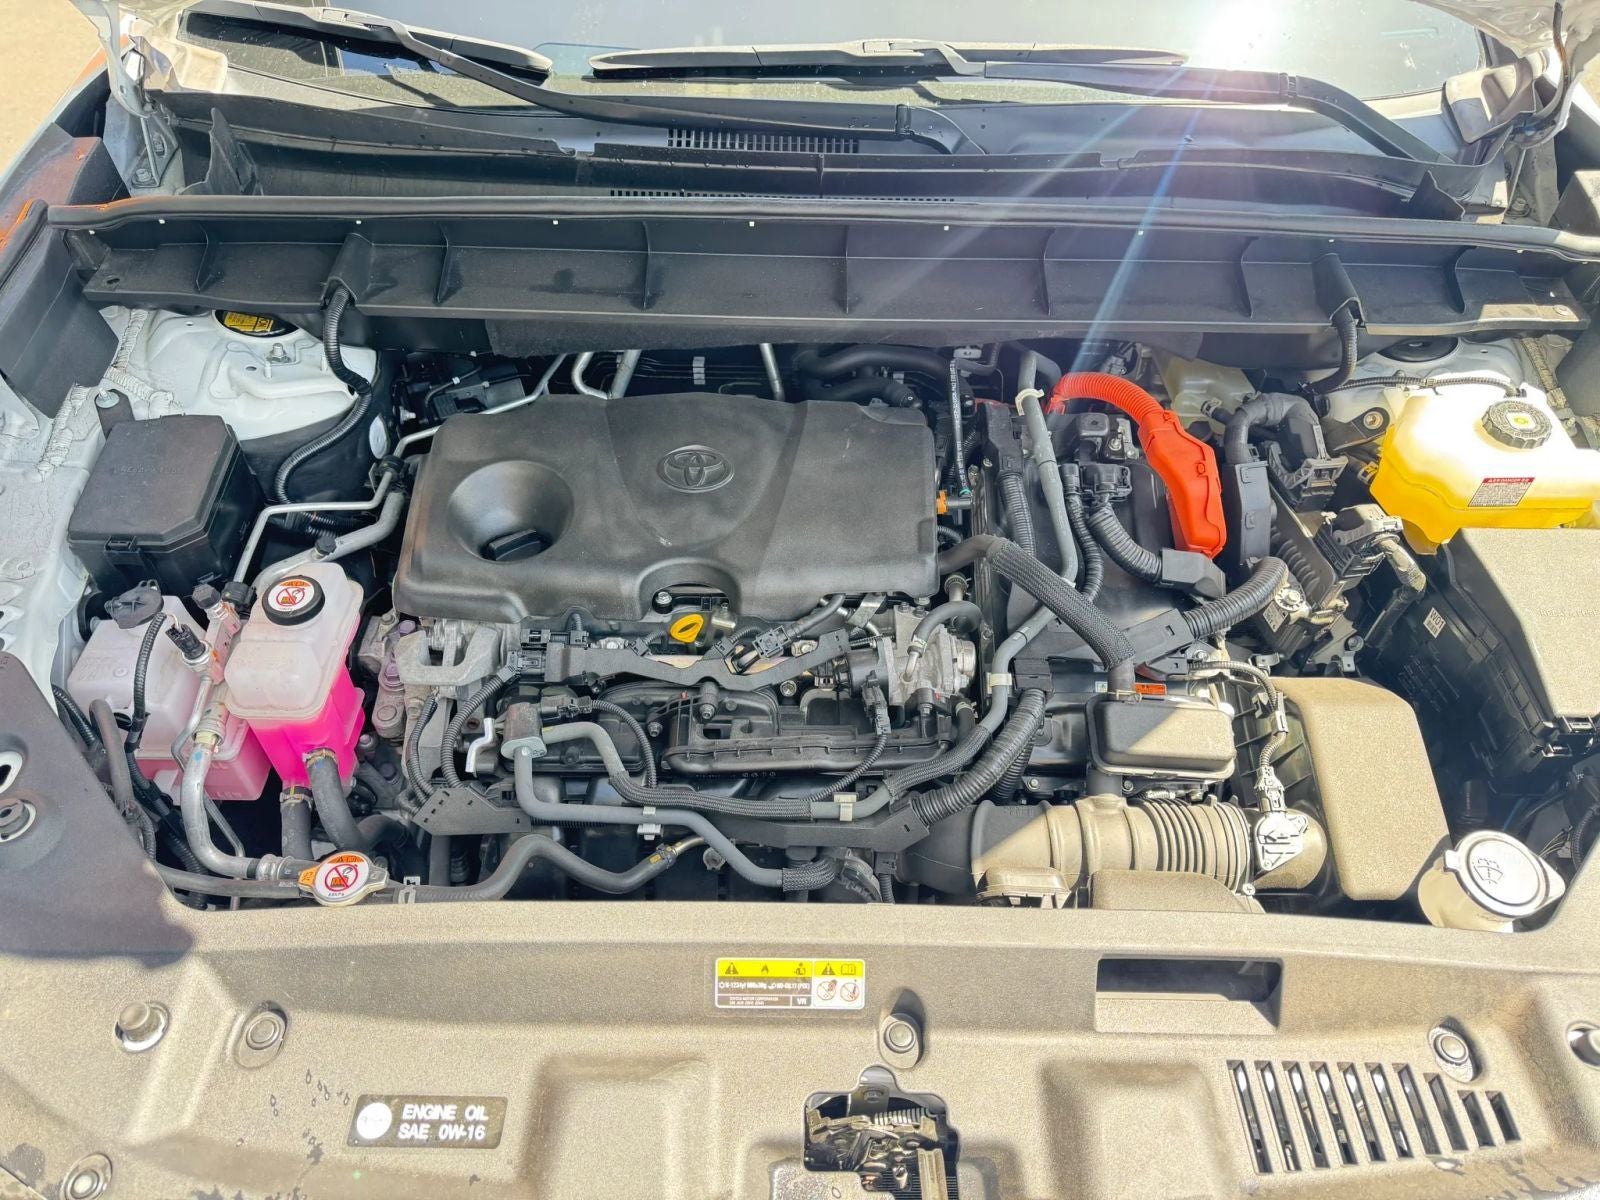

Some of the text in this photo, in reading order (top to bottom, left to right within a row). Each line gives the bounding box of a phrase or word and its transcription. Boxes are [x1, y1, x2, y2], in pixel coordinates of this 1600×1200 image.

[402, 1103, 489, 1121] ENGINE OIL
[398, 1123, 486, 1140] SAE 0W-16
